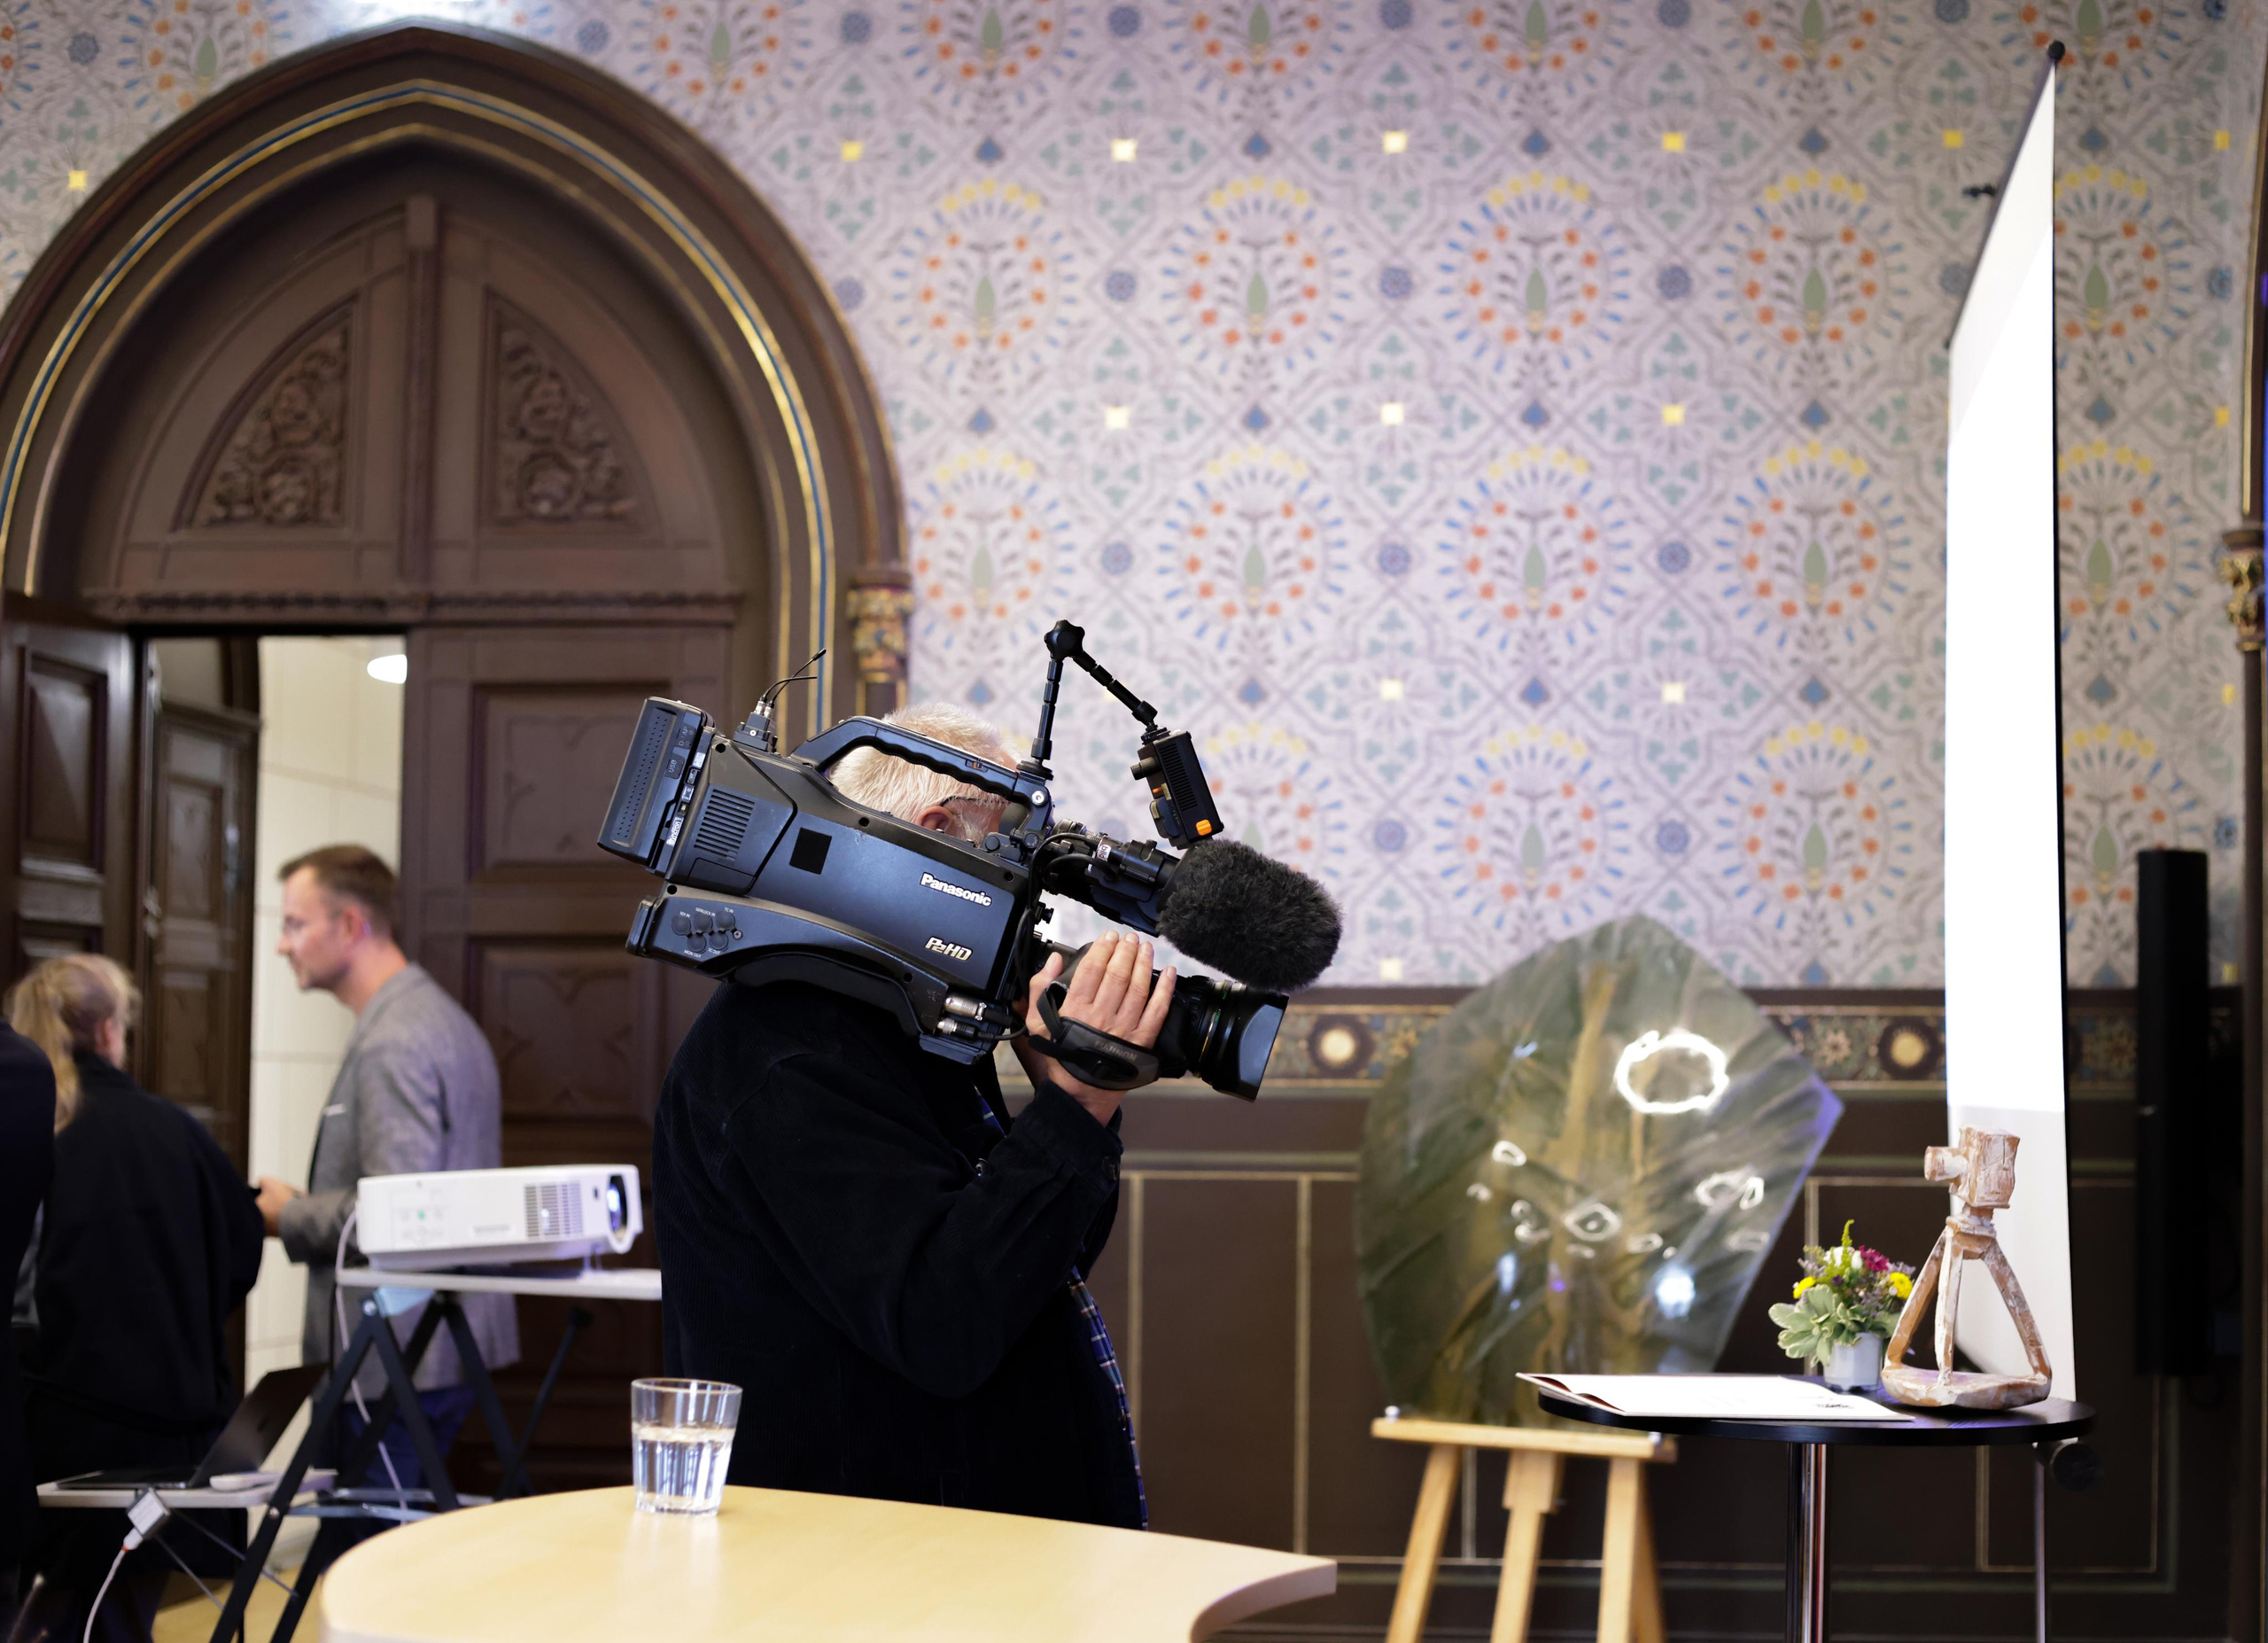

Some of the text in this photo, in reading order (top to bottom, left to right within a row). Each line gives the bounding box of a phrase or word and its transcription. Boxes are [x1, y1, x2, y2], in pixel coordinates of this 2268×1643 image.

[668, 759, 677, 773] USB
[920, 872, 992, 906] Panasonic
[695, 907, 711, 915] GENLOCK
[924, 936, 973, 962] P2HD
[1094, 1040, 1138, 1062] FUJINON
